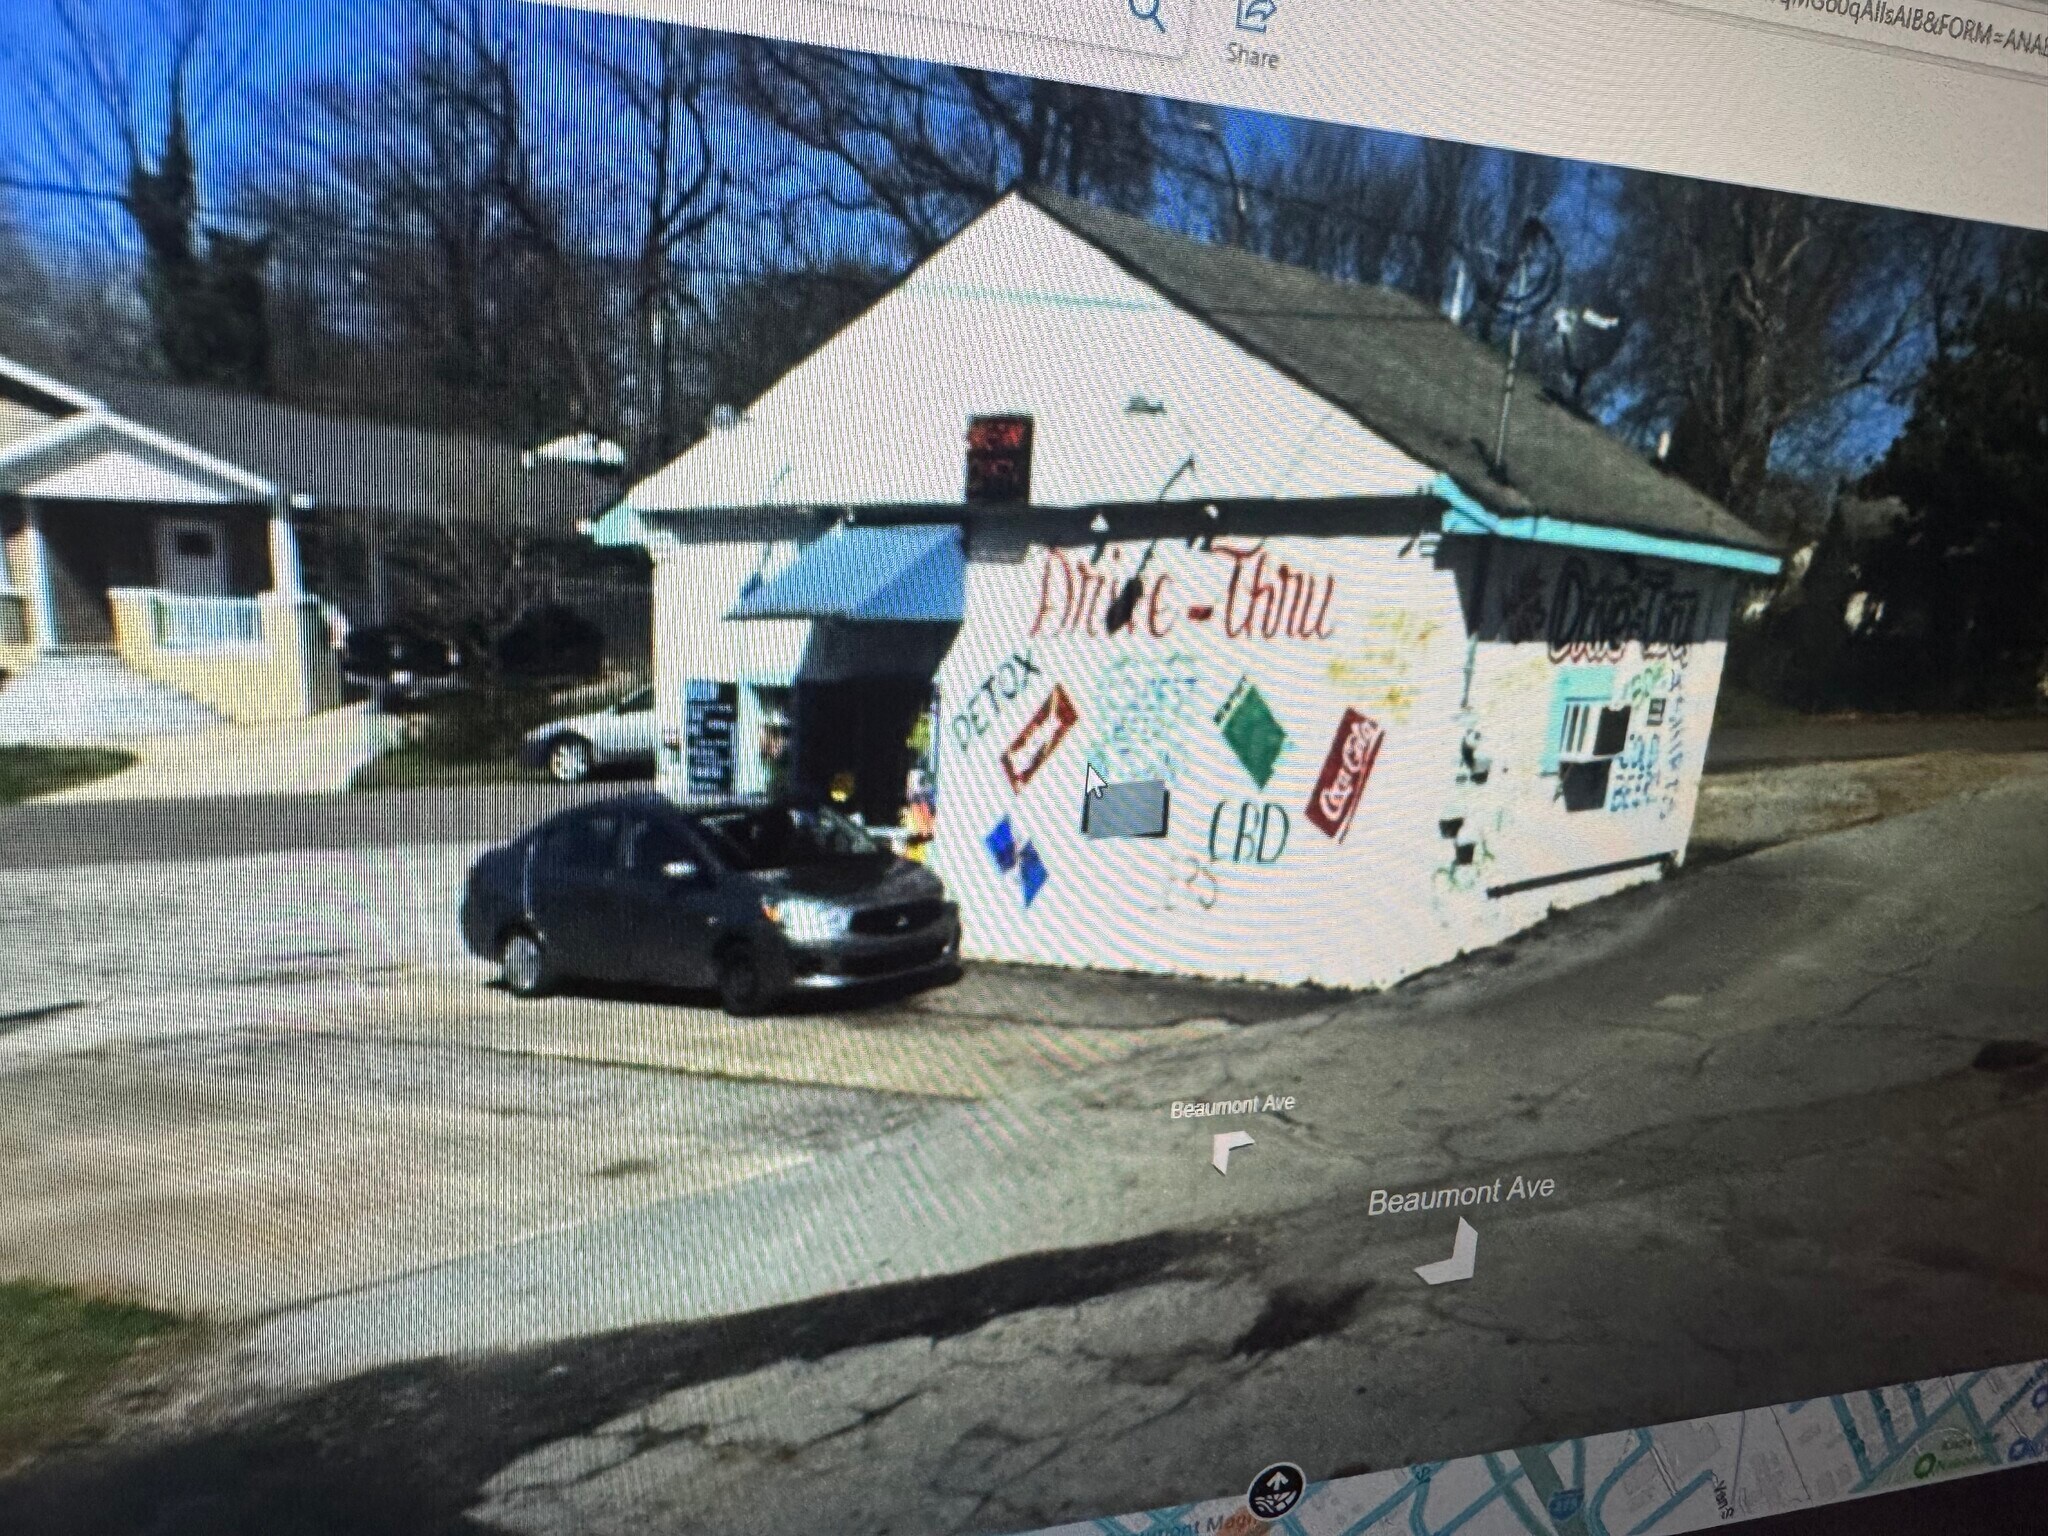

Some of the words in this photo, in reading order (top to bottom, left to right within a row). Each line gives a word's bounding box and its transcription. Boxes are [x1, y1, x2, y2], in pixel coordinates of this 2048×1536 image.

[1226, 41, 1280, 69] Share
[952, 649, 1042, 752] DETOX
[1209, 800, 1290, 863] CBD
[1170, 1095, 1259, 1119] Beaumont
[1261, 1094, 1297, 1113] Ave
[1368, 1178, 1502, 1216] Beaumont
[1506, 1175, 1555, 1201] Ave
